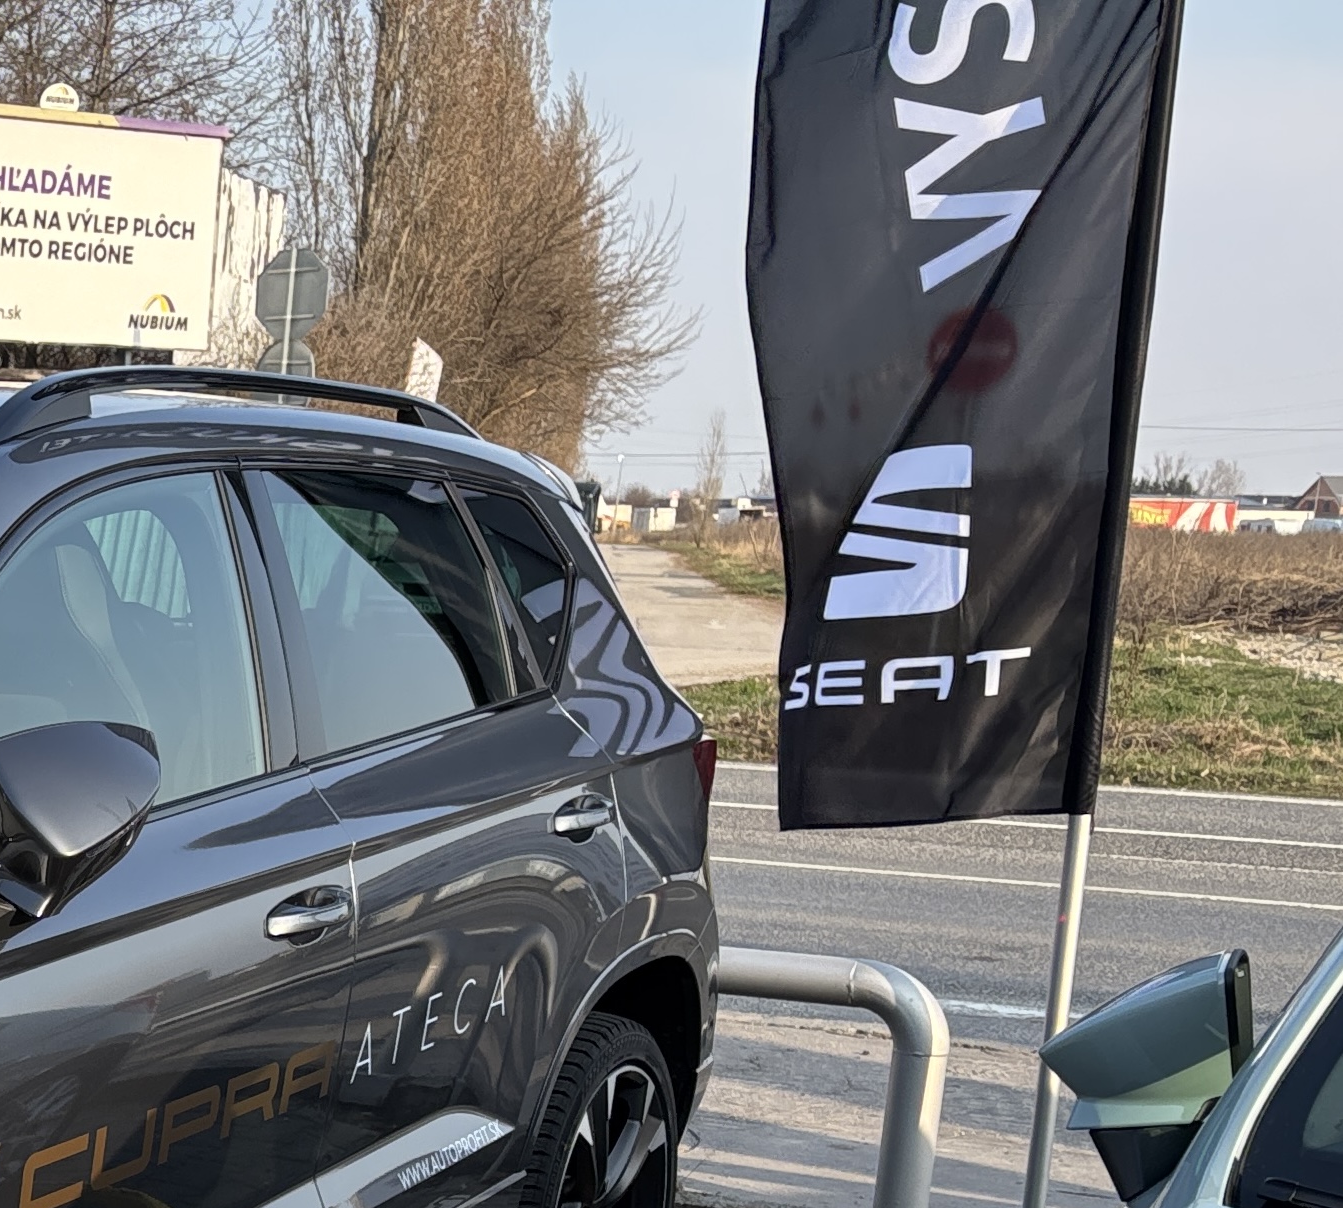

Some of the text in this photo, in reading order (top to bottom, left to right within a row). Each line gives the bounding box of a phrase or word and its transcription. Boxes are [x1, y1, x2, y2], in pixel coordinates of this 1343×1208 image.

[33, 209, 62, 231] NA
[67, 208, 129, 236] VÝLEP
[133, 213, 195, 240] PLÔCH
[48, 238, 134, 265] REGIÓNE
[128, 314, 189, 331] NUBIUM
[784, 646, 1032, 711] SEAT
[349, 965, 507, 1085] ATECA
[397, 1119, 504, 1191] WWW.AUTOPROFIT.SK
